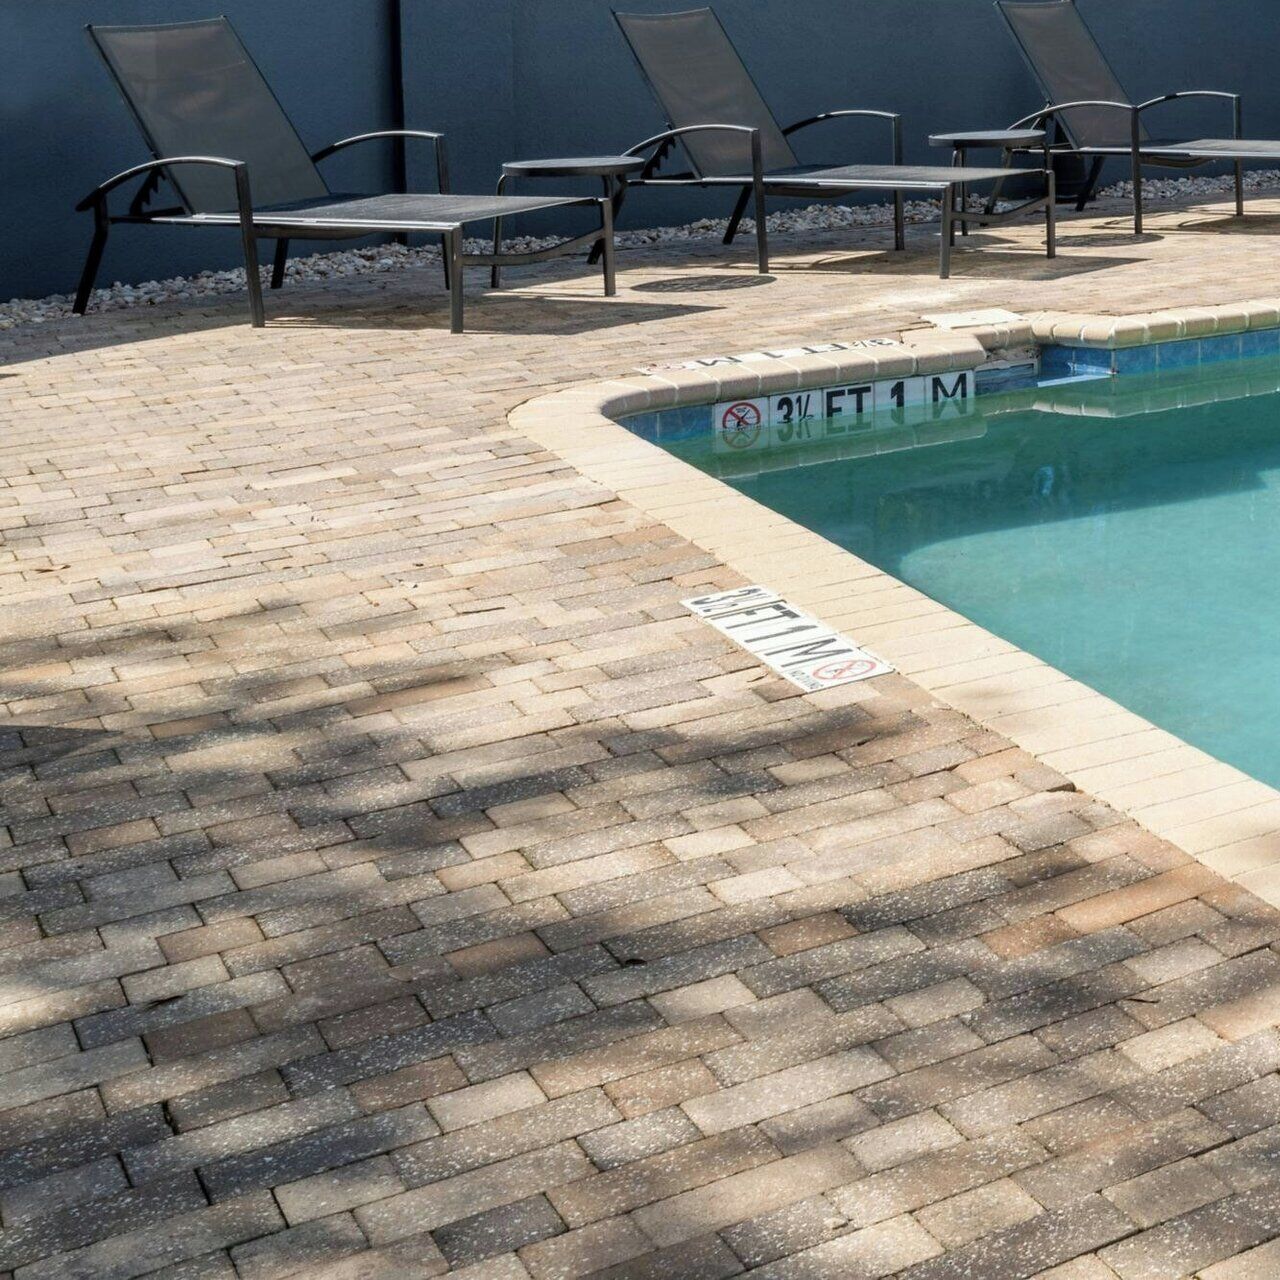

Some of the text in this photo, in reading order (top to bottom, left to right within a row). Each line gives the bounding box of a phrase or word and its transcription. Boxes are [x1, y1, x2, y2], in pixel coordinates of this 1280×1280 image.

[826, 386, 872, 418] FT
[890, 380, 905, 408] 1
[932, 373, 968, 403] M
[710, 603, 801, 629] FT
[744, 624, 819, 644] 1
[764, 638, 853, 668] M
